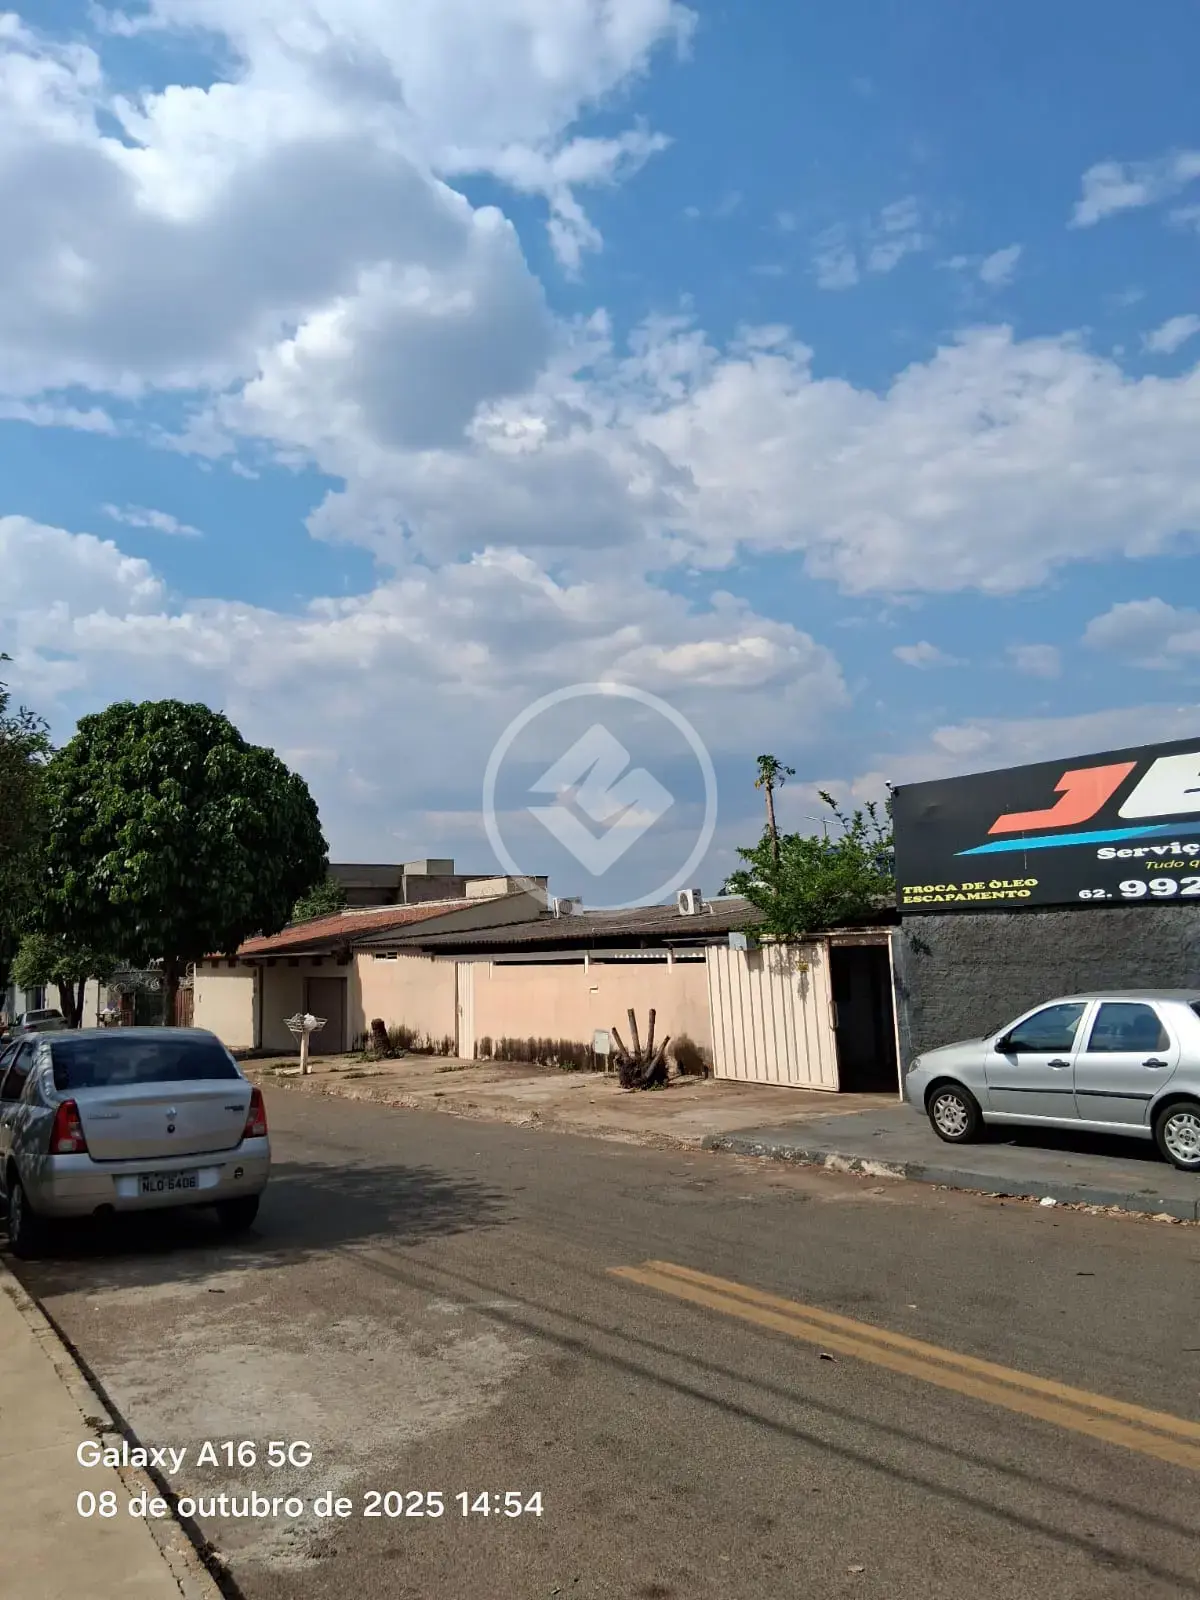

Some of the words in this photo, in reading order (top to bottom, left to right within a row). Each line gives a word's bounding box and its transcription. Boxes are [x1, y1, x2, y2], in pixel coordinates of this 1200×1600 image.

[1145, 860, 1184, 870] Tudo
[902, 884, 958, 894] TROCA
[962, 882, 985, 891] DE
[1078, 888, 1113, 899] 62.
[1119, 876, 1200, 897] 992
[903, 889, 1031, 904] ESCAPAMENTO
